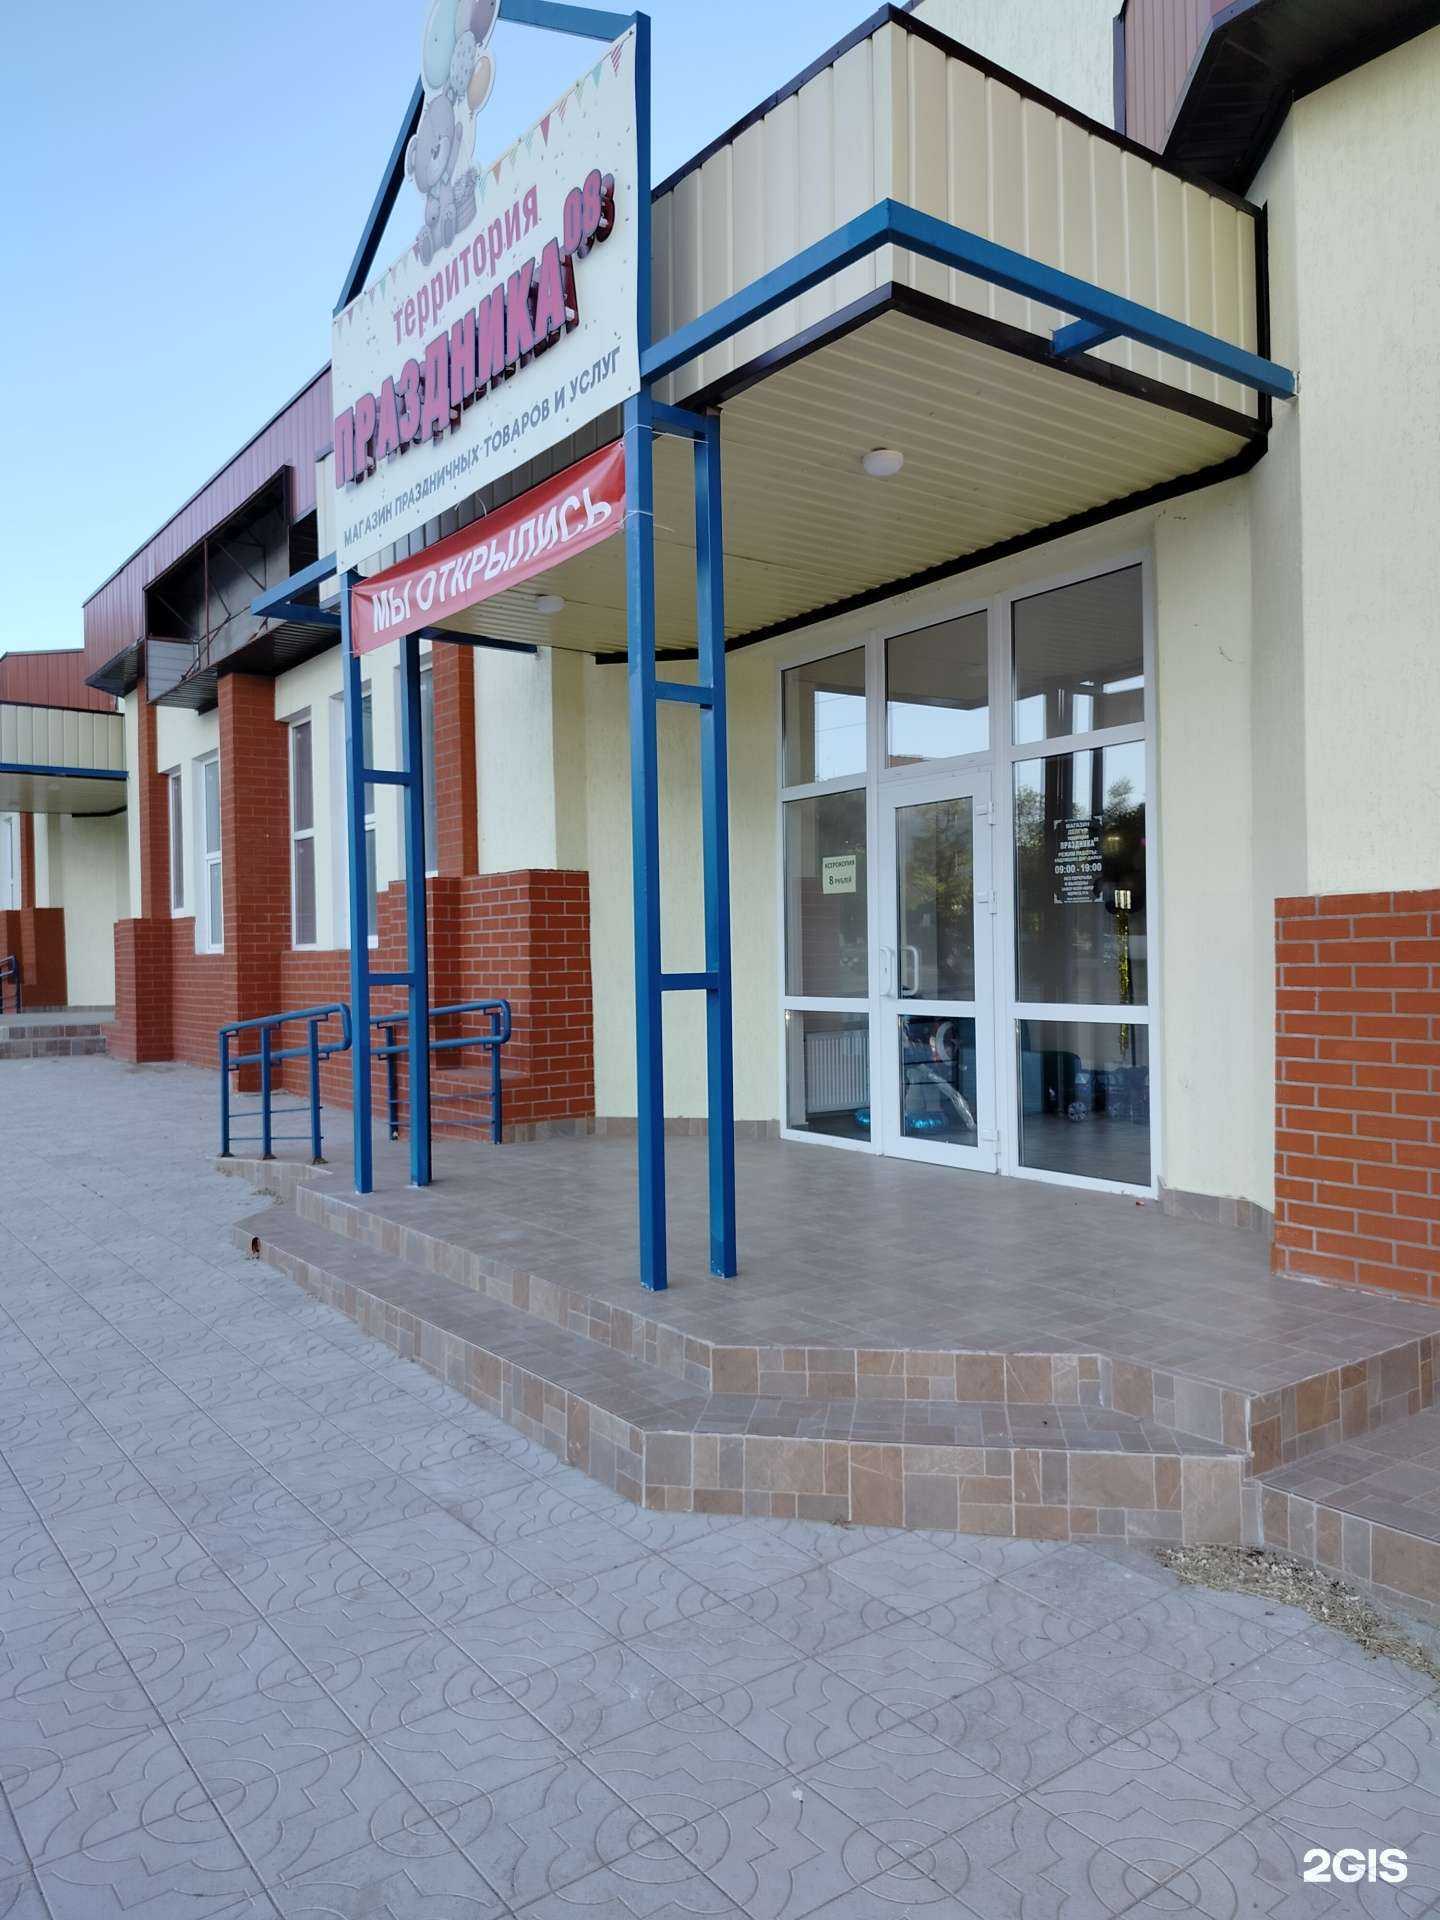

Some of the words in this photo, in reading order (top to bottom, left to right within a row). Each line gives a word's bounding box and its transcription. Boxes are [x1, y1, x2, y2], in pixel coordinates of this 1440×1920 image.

[393, 184, 541, 345] территория
[335, 237, 576, 490] ПРАЗДНИКА
[343, 497, 394, 549] МАГАЗИН
[394, 447, 480, 515] ПРАЗДНИЧНЫХ
[483, 398, 551, 459] ТОВАРОВ
[554, 387, 567, 414] И
[570, 347, 622, 404] УСЛУГ
[371, 582, 411, 634] МЫ
[415, 487, 613, 613] ОТКРЫЛИСЬ
[829, 875, 834, 885] 8
[1055, 865, 1076, 874] 09:00
[1081, 863, 1102, 873] 19:00
[1060, 840, 1095, 850] ПРАЗДНИКА
